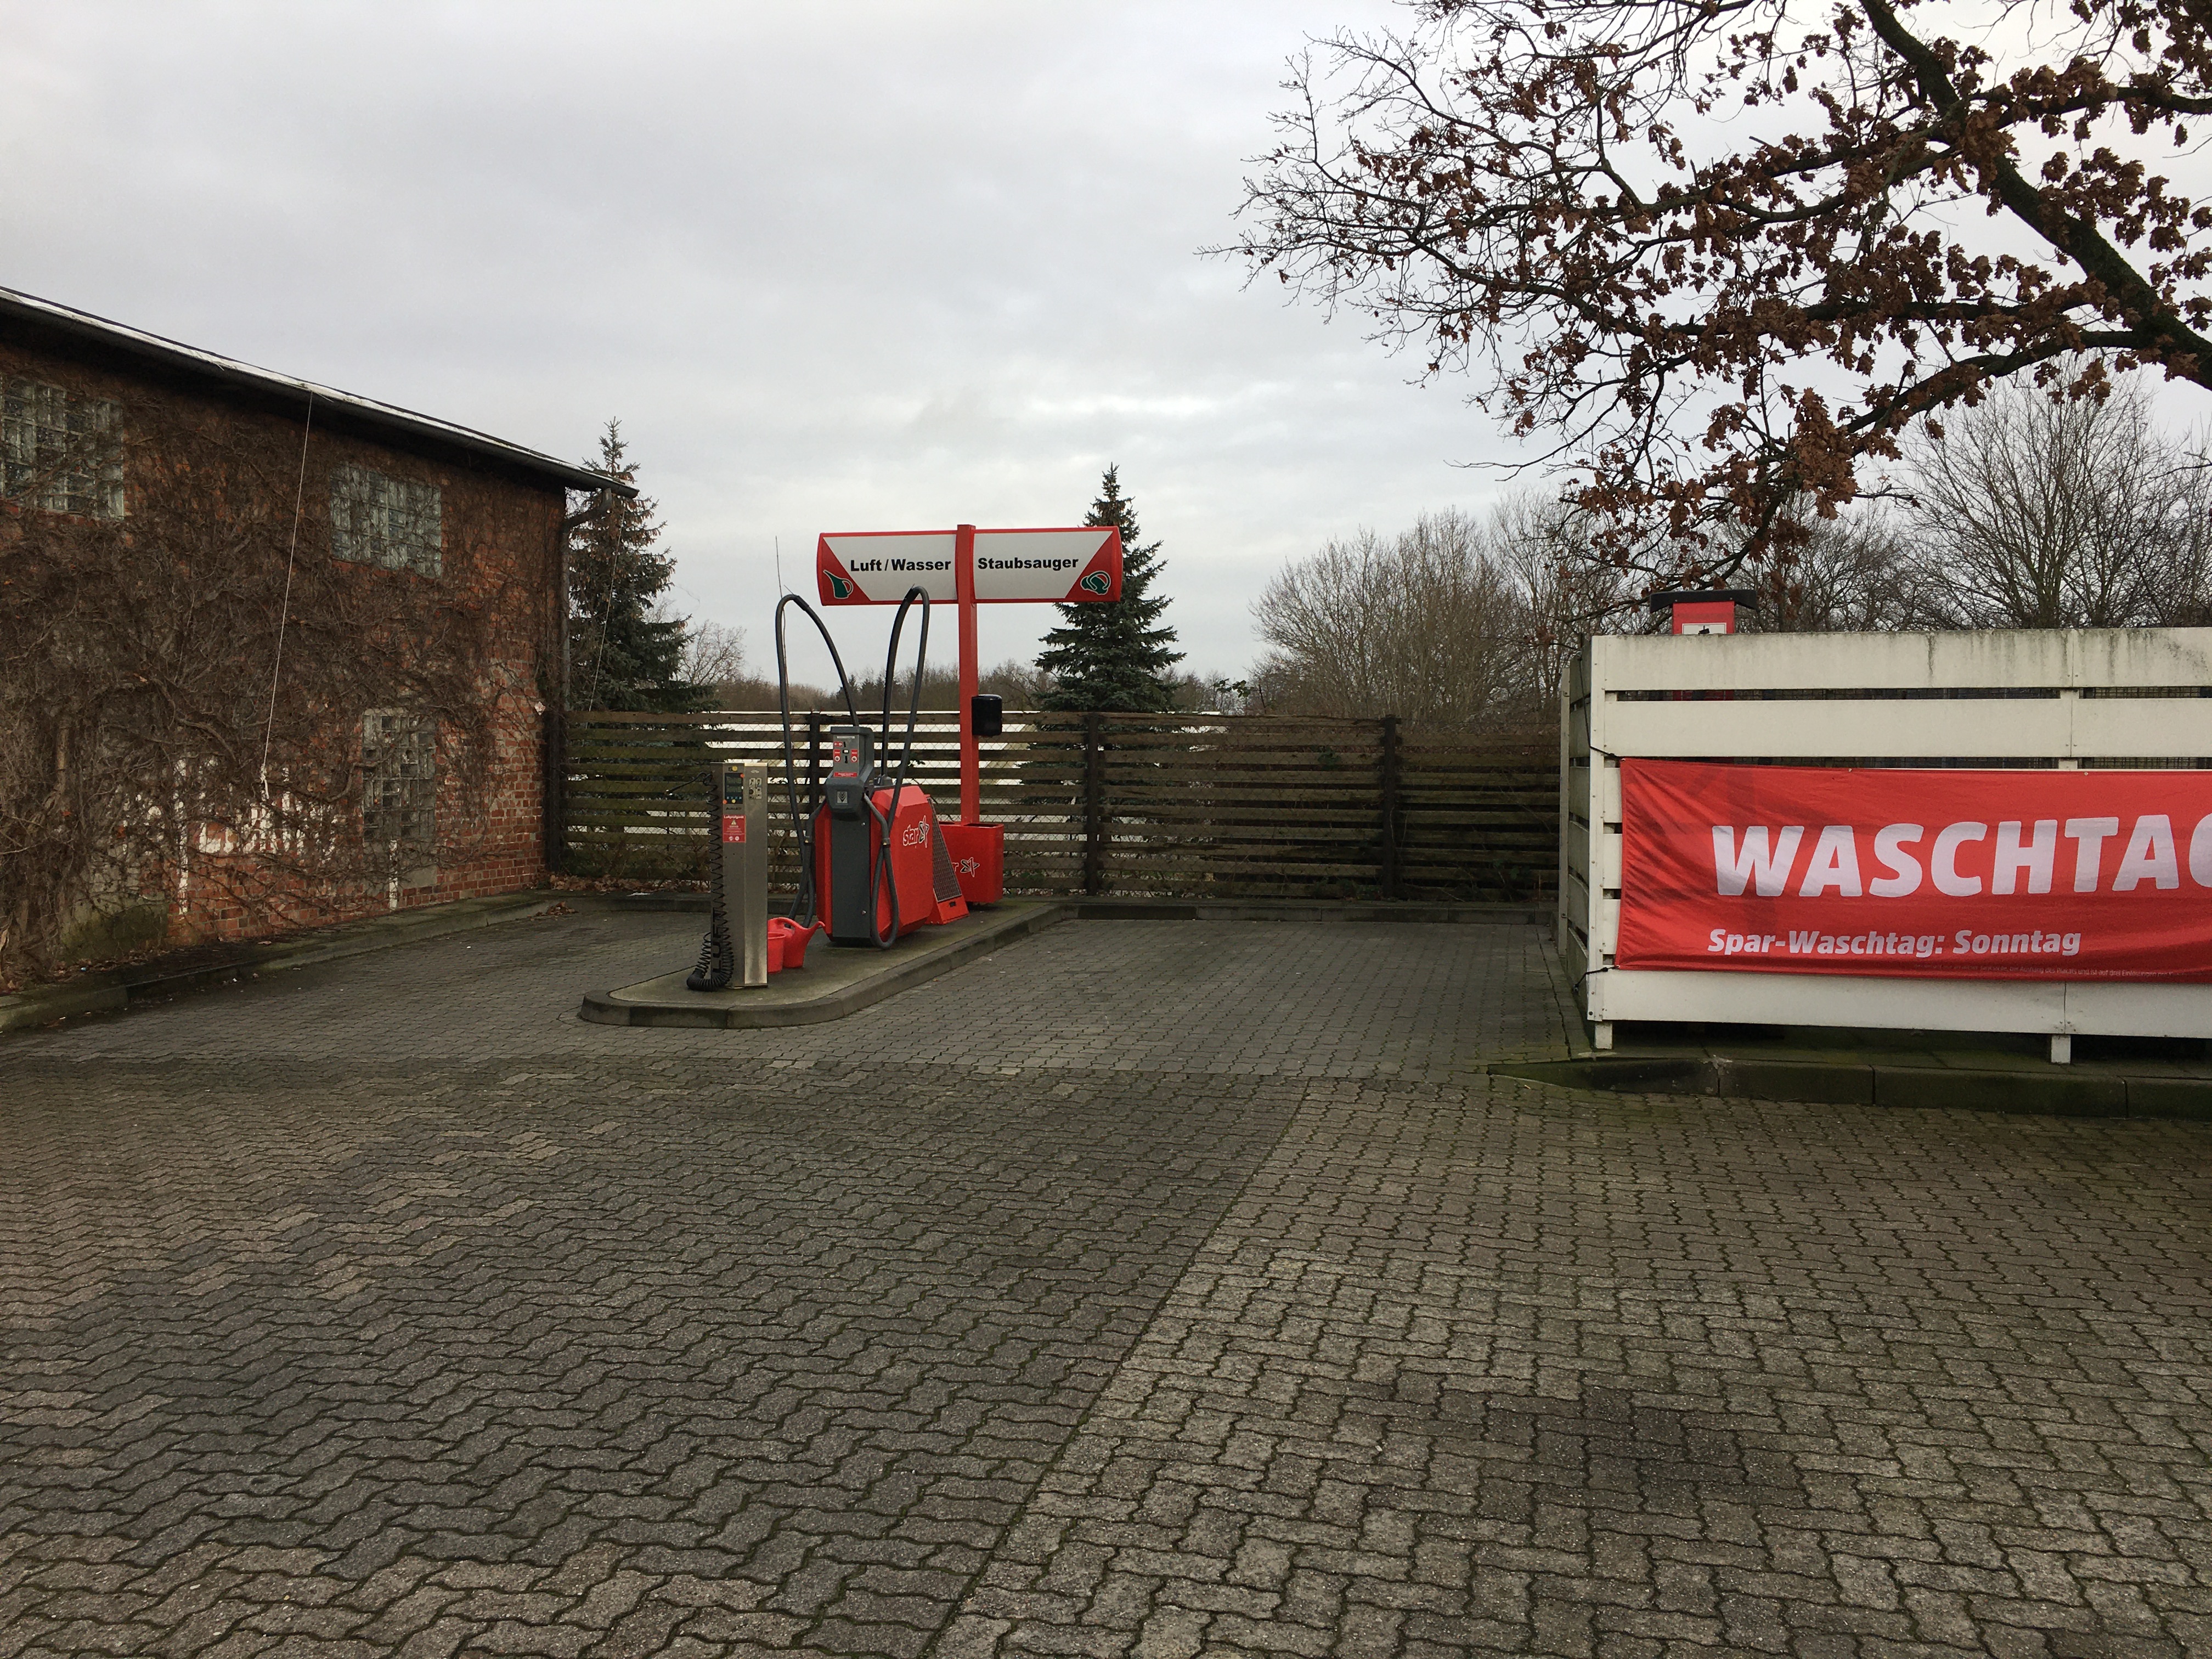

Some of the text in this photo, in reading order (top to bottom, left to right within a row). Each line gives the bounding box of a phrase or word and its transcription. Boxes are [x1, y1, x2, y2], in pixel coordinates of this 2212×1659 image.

[978, 557, 1079, 571] Staubsauger
[902, 825, 919, 846] star
[1707, 928, 2081, 958] Spar-Waschtag: Sonntag
